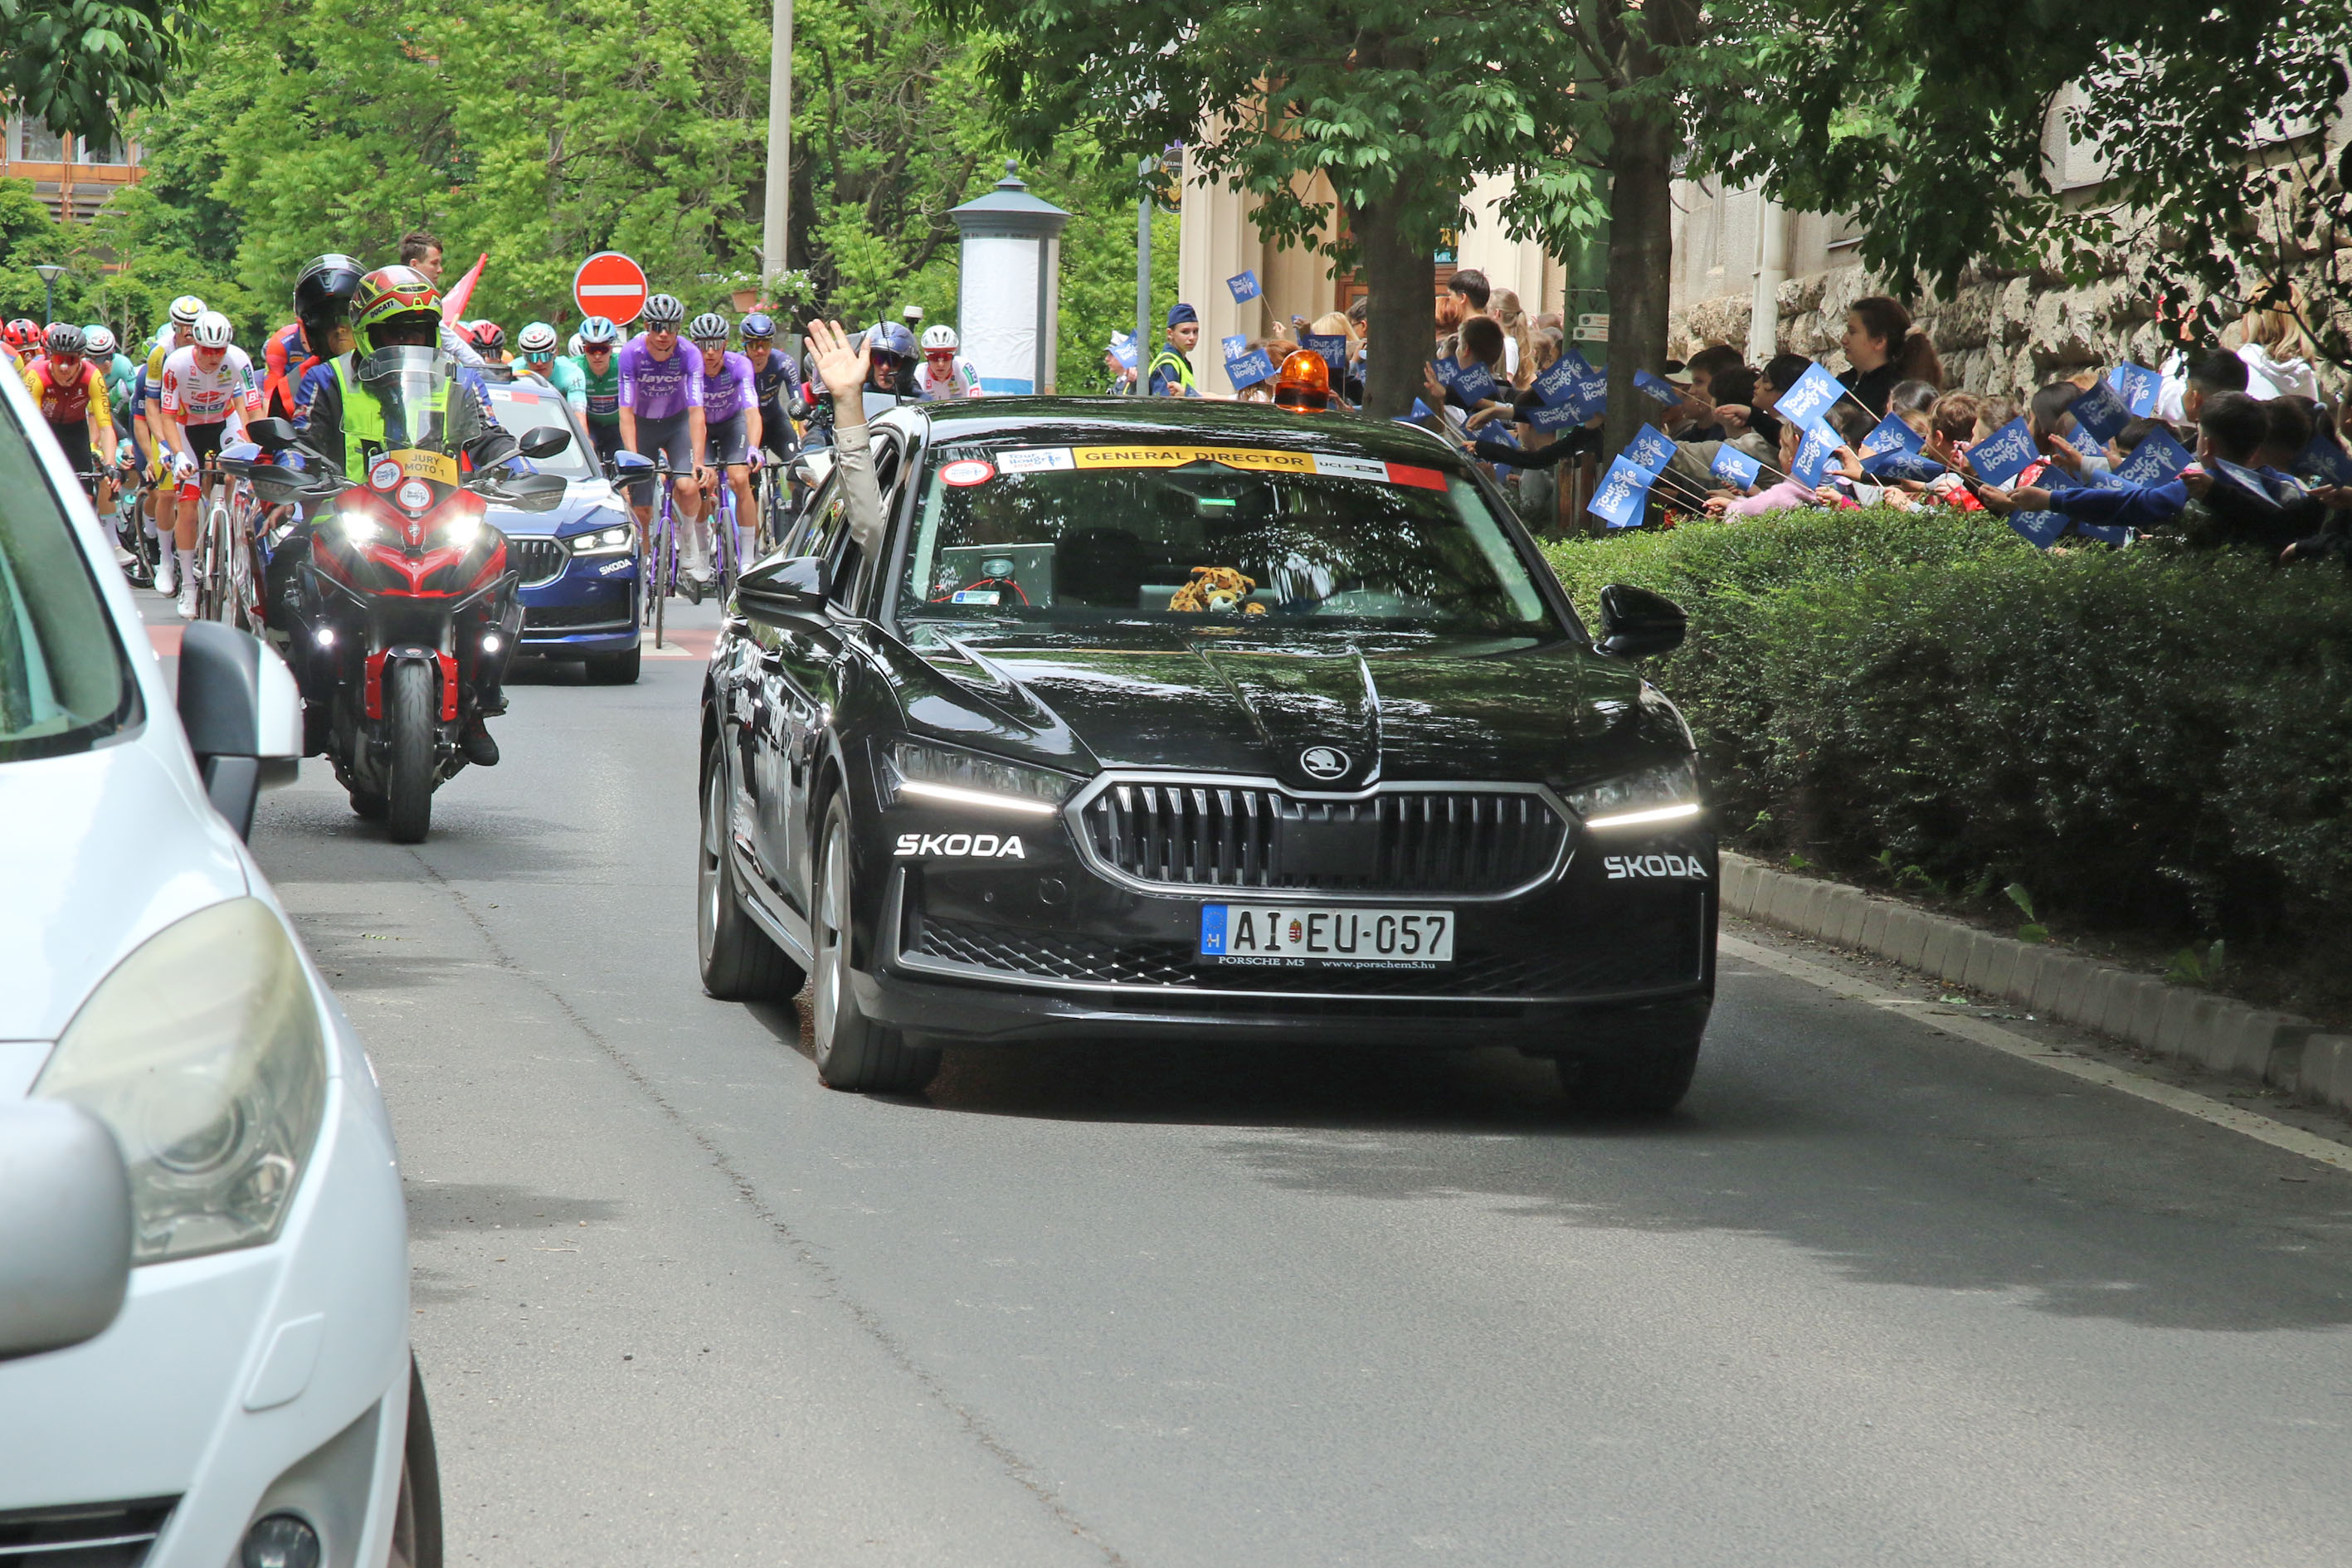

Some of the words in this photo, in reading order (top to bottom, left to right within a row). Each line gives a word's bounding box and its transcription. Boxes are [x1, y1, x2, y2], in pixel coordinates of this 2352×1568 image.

[370, 300, 394, 319] DUCATI
[1308, 338, 1327, 347] Tour
[1230, 360, 1249, 371] Tour
[637, 373, 682, 384] Jayco
[787, 368, 800, 387] UBS
[1458, 369, 1479, 384] Tour
[1538, 368, 1561, 387] Tour
[1579, 378, 1606, 391] Tour
[703, 387, 735, 401] ayco
[1782, 387, 1806, 411] Tour
[190, 402, 224, 411] ALTEZ
[2078, 390, 2108, 414] Tour
[1534, 407, 1561, 418] Tour
[1796, 441, 1811, 469] Tour
[1975, 438, 2006, 460] Tour
[1983, 436, 2030, 472] Hongrie
[411, 455, 441, 465] JURY
[1085, 451, 1188, 460] GENERAL
[1195, 452, 1304, 466] DIRECTOR
[2135, 447, 2172, 485] ongrie
[404, 464, 436, 474] MOTO
[1595, 482, 1616, 508] Tour
[2017, 511, 2034, 523] To
[598, 558, 633, 576] SKODA
[1206, 933, 1220, 947] H
[1218, 956, 1281, 966] PORSCHE
[1322, 961, 1436, 969] www.porschem5.hu
